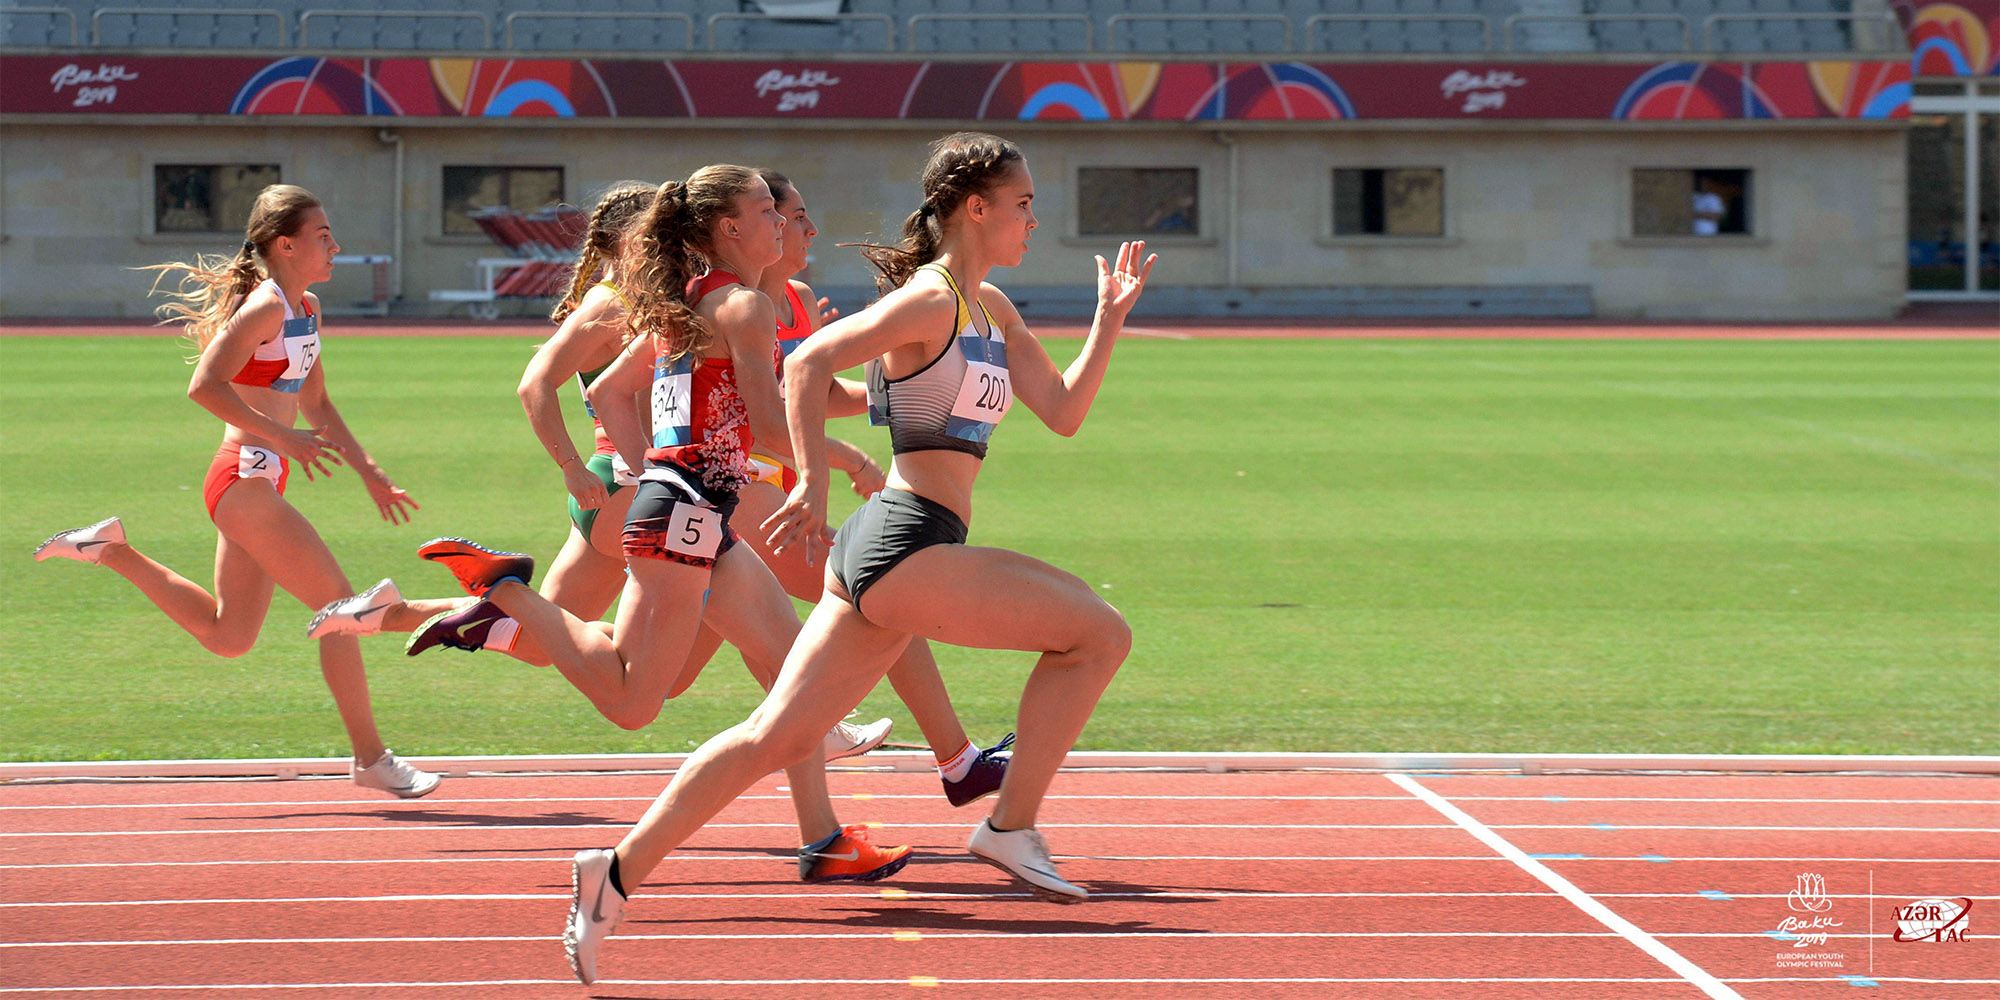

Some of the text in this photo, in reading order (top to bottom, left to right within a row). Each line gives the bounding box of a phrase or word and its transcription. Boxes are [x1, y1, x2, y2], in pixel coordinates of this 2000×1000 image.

[50, 64, 138, 92] Baku
[755, 69, 840, 97] Baku
[1441, 70, 1526, 98] Baku
[73, 85, 117, 107] 2019
[776, 90, 819, 111] 2019
[1461, 91, 1505, 112] 2019
[299, 339, 316, 373] 75
[975, 373, 1007, 413] 201
[251, 450, 267, 471] 2
[680, 517, 704, 546] 5
